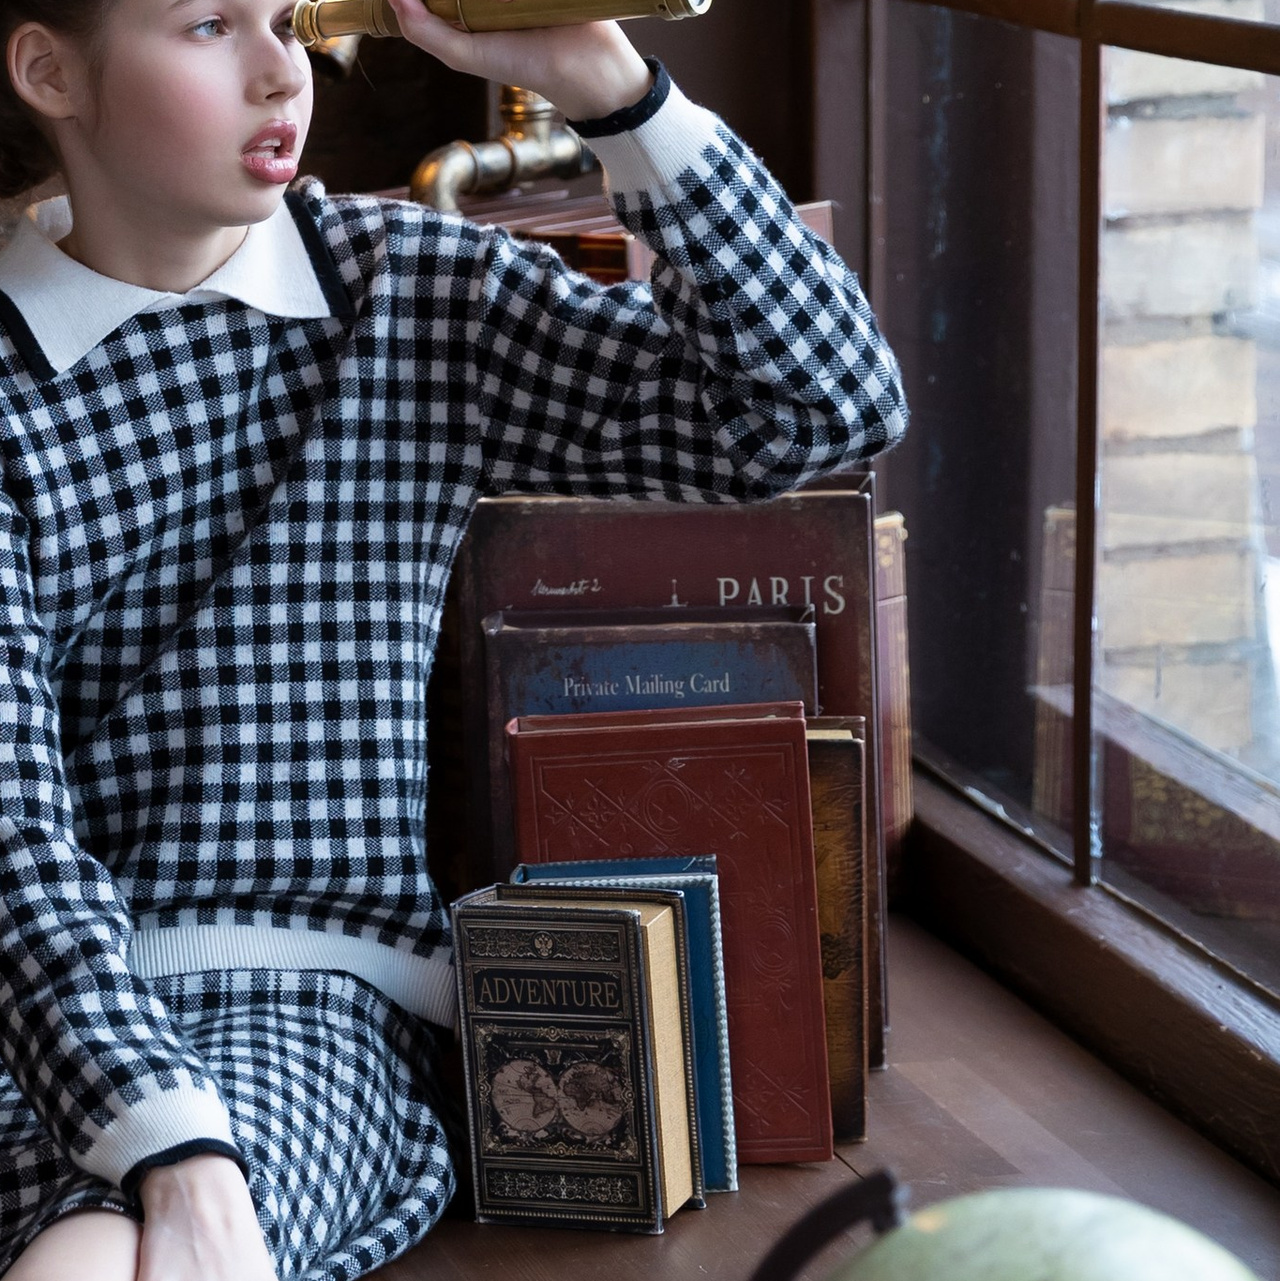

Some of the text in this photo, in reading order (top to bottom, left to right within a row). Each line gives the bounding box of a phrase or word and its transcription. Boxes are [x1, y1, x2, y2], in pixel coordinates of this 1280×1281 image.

[716, 575, 846, 615] PARIS
[564, 672, 731, 699] Private Mailing Card
[479, 977, 621, 1008] ADVENTURE
